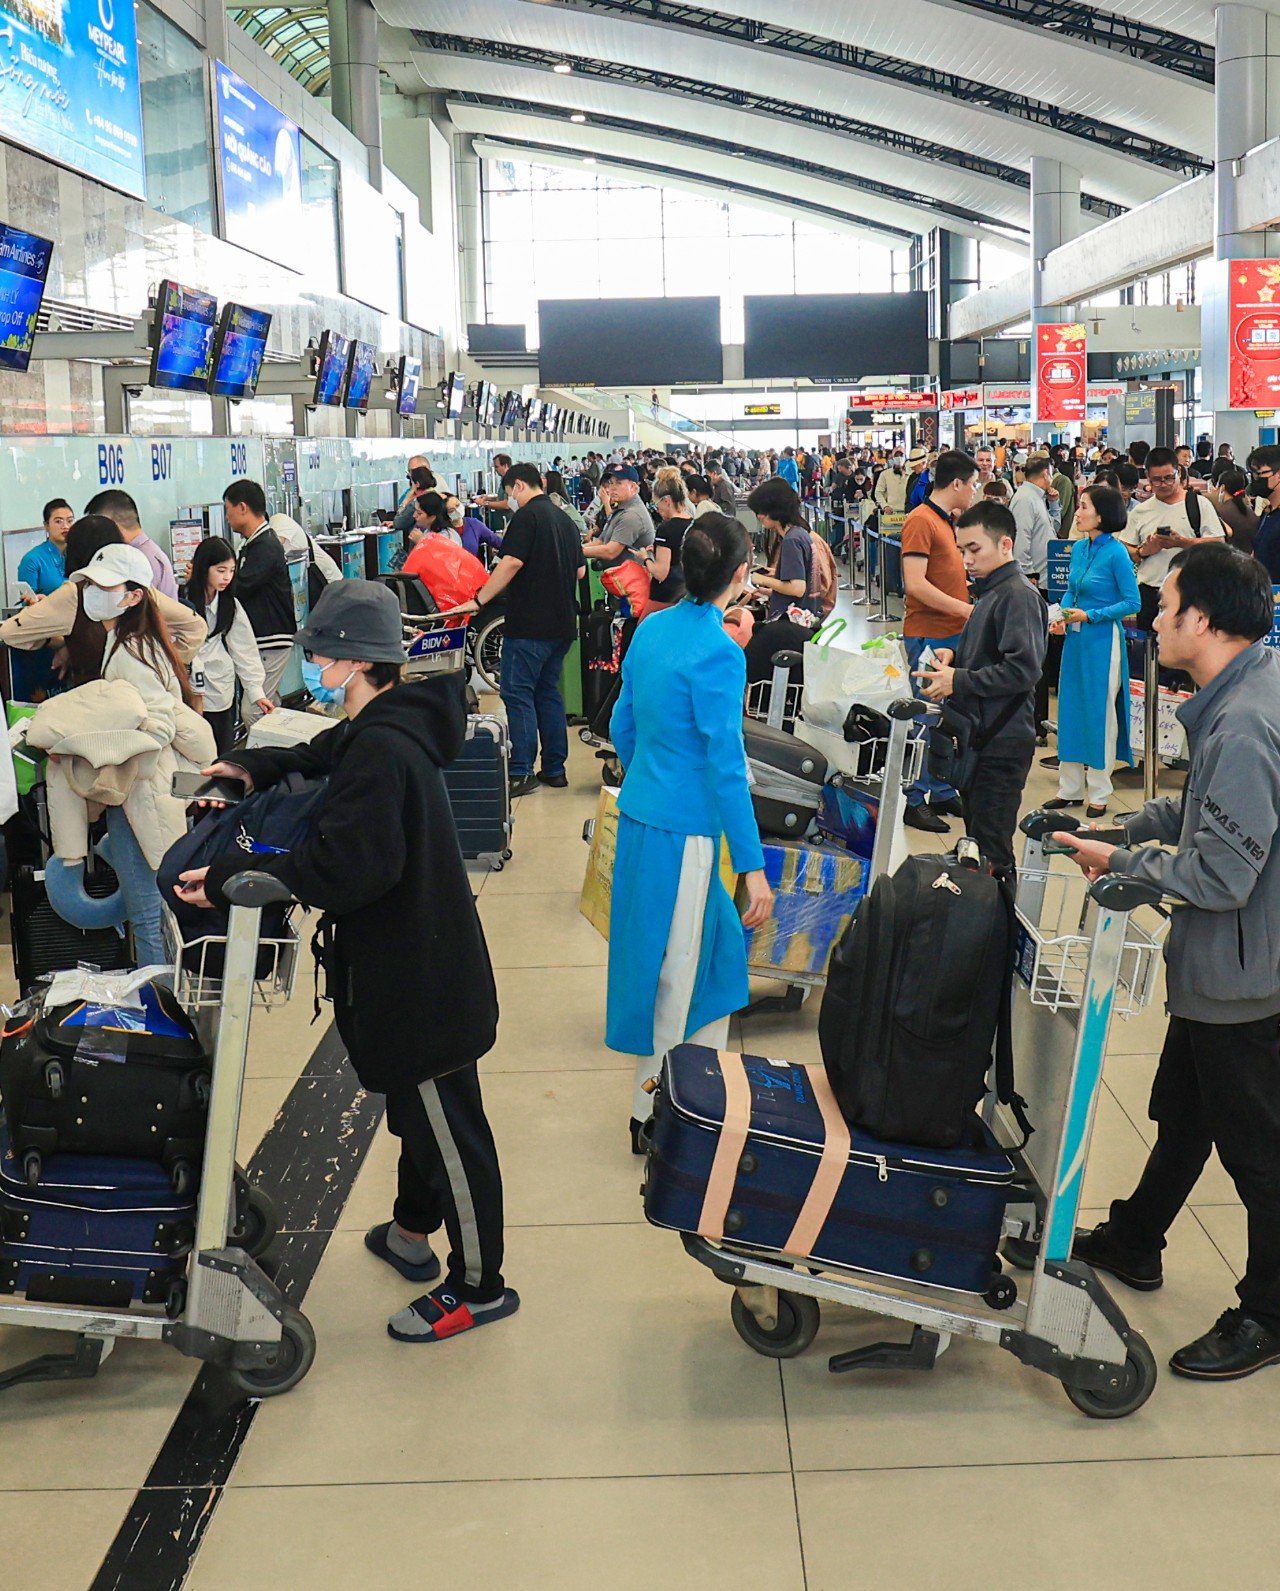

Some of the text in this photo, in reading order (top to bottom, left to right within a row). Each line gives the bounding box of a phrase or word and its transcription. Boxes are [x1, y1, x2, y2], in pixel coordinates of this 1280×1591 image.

[12, 310, 24, 326] Off
[99, 444, 124, 484] B06
[151, 443, 172, 481] B07
[230, 443, 247, 475] B08
[1051, 572, 1065, 580] CHỜ
[422, 636, 443, 650] BIDV
[195, 671, 205, 688] 9
